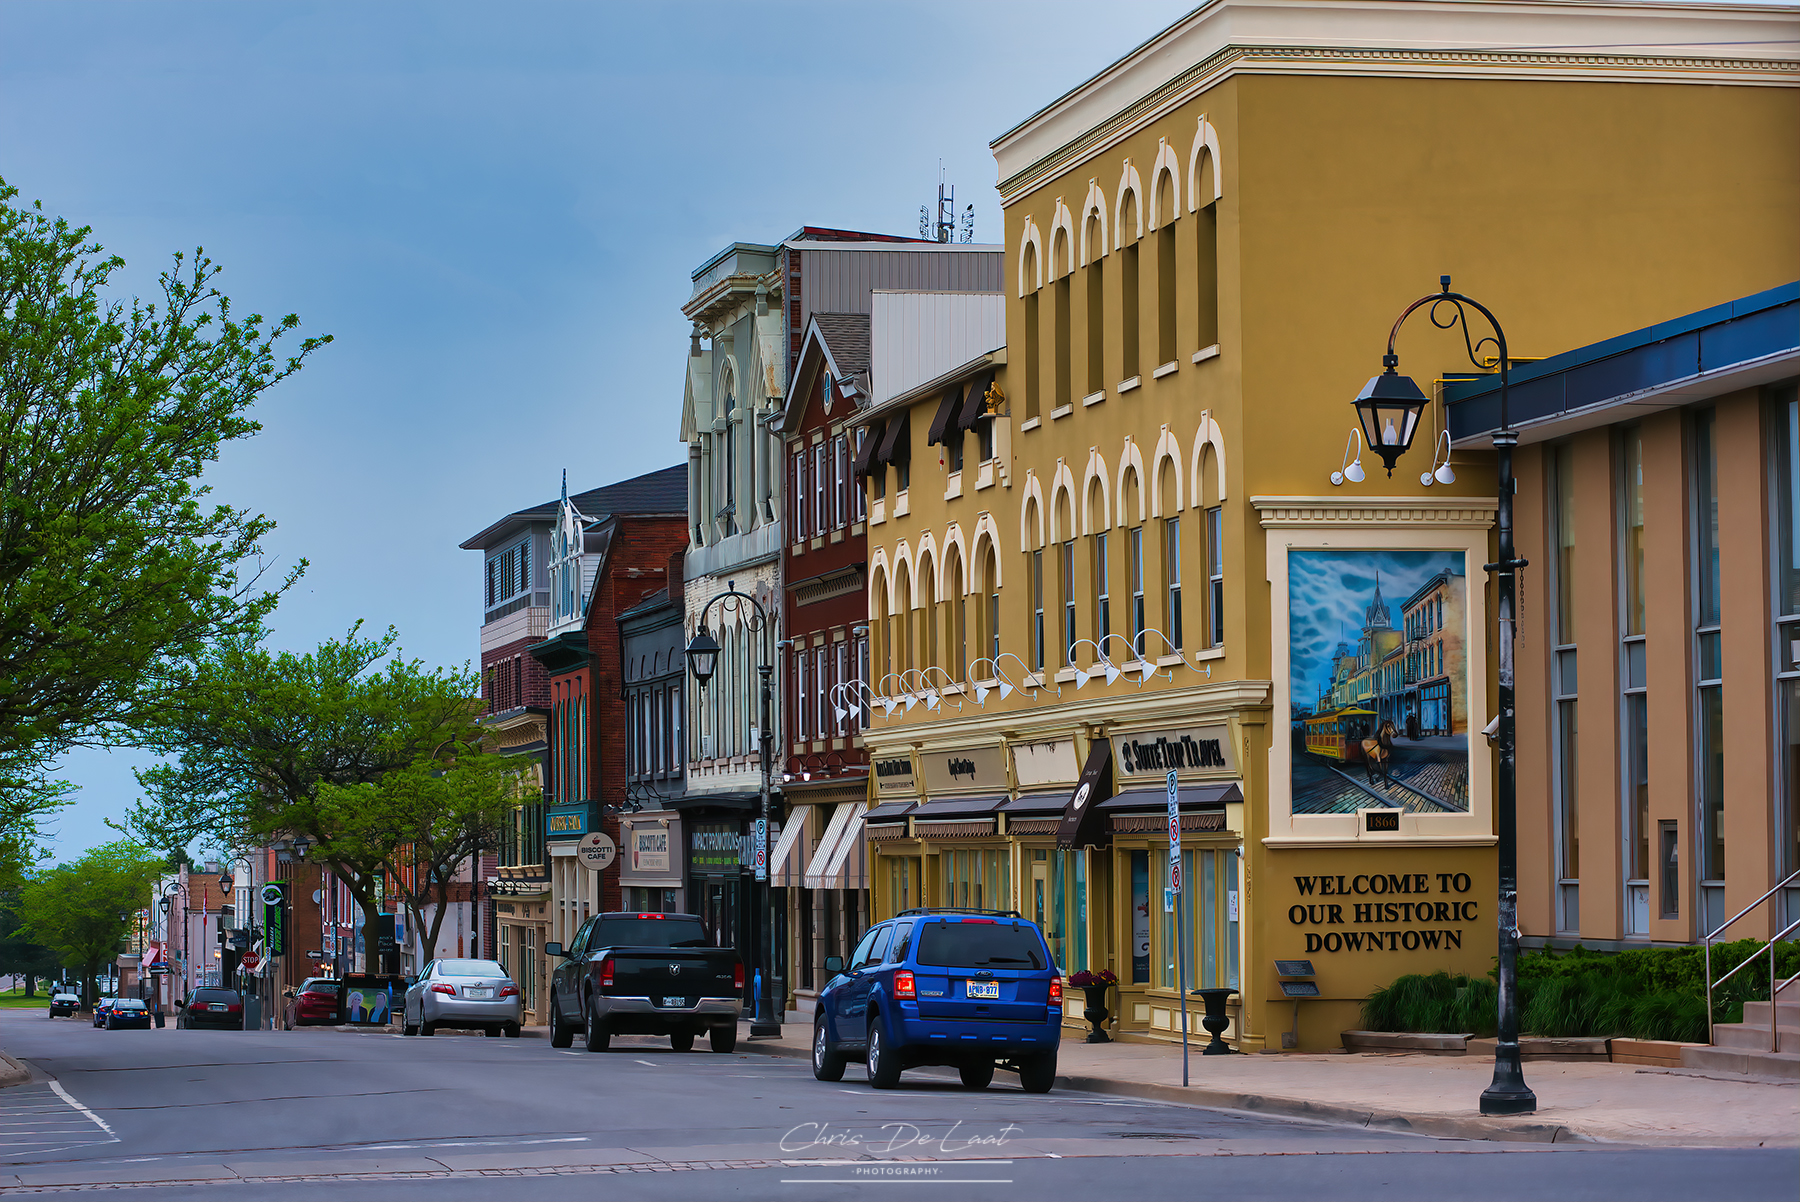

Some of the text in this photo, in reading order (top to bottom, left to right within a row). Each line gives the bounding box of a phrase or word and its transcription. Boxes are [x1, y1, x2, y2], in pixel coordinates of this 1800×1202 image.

[1369, 815, 1396, 828] 1866
[656, 834, 667, 852] CAFE
[692, 832, 709, 850] IMPACT
[709, 831, 740, 850] PROMOTIONS
[1293, 872, 1472, 896] WELCOME TO
[1288, 901, 1478, 925] OUR HISTORIC
[1304, 929, 1462, 953] DOWNTOWN
[242, 956, 259, 964] STOP
